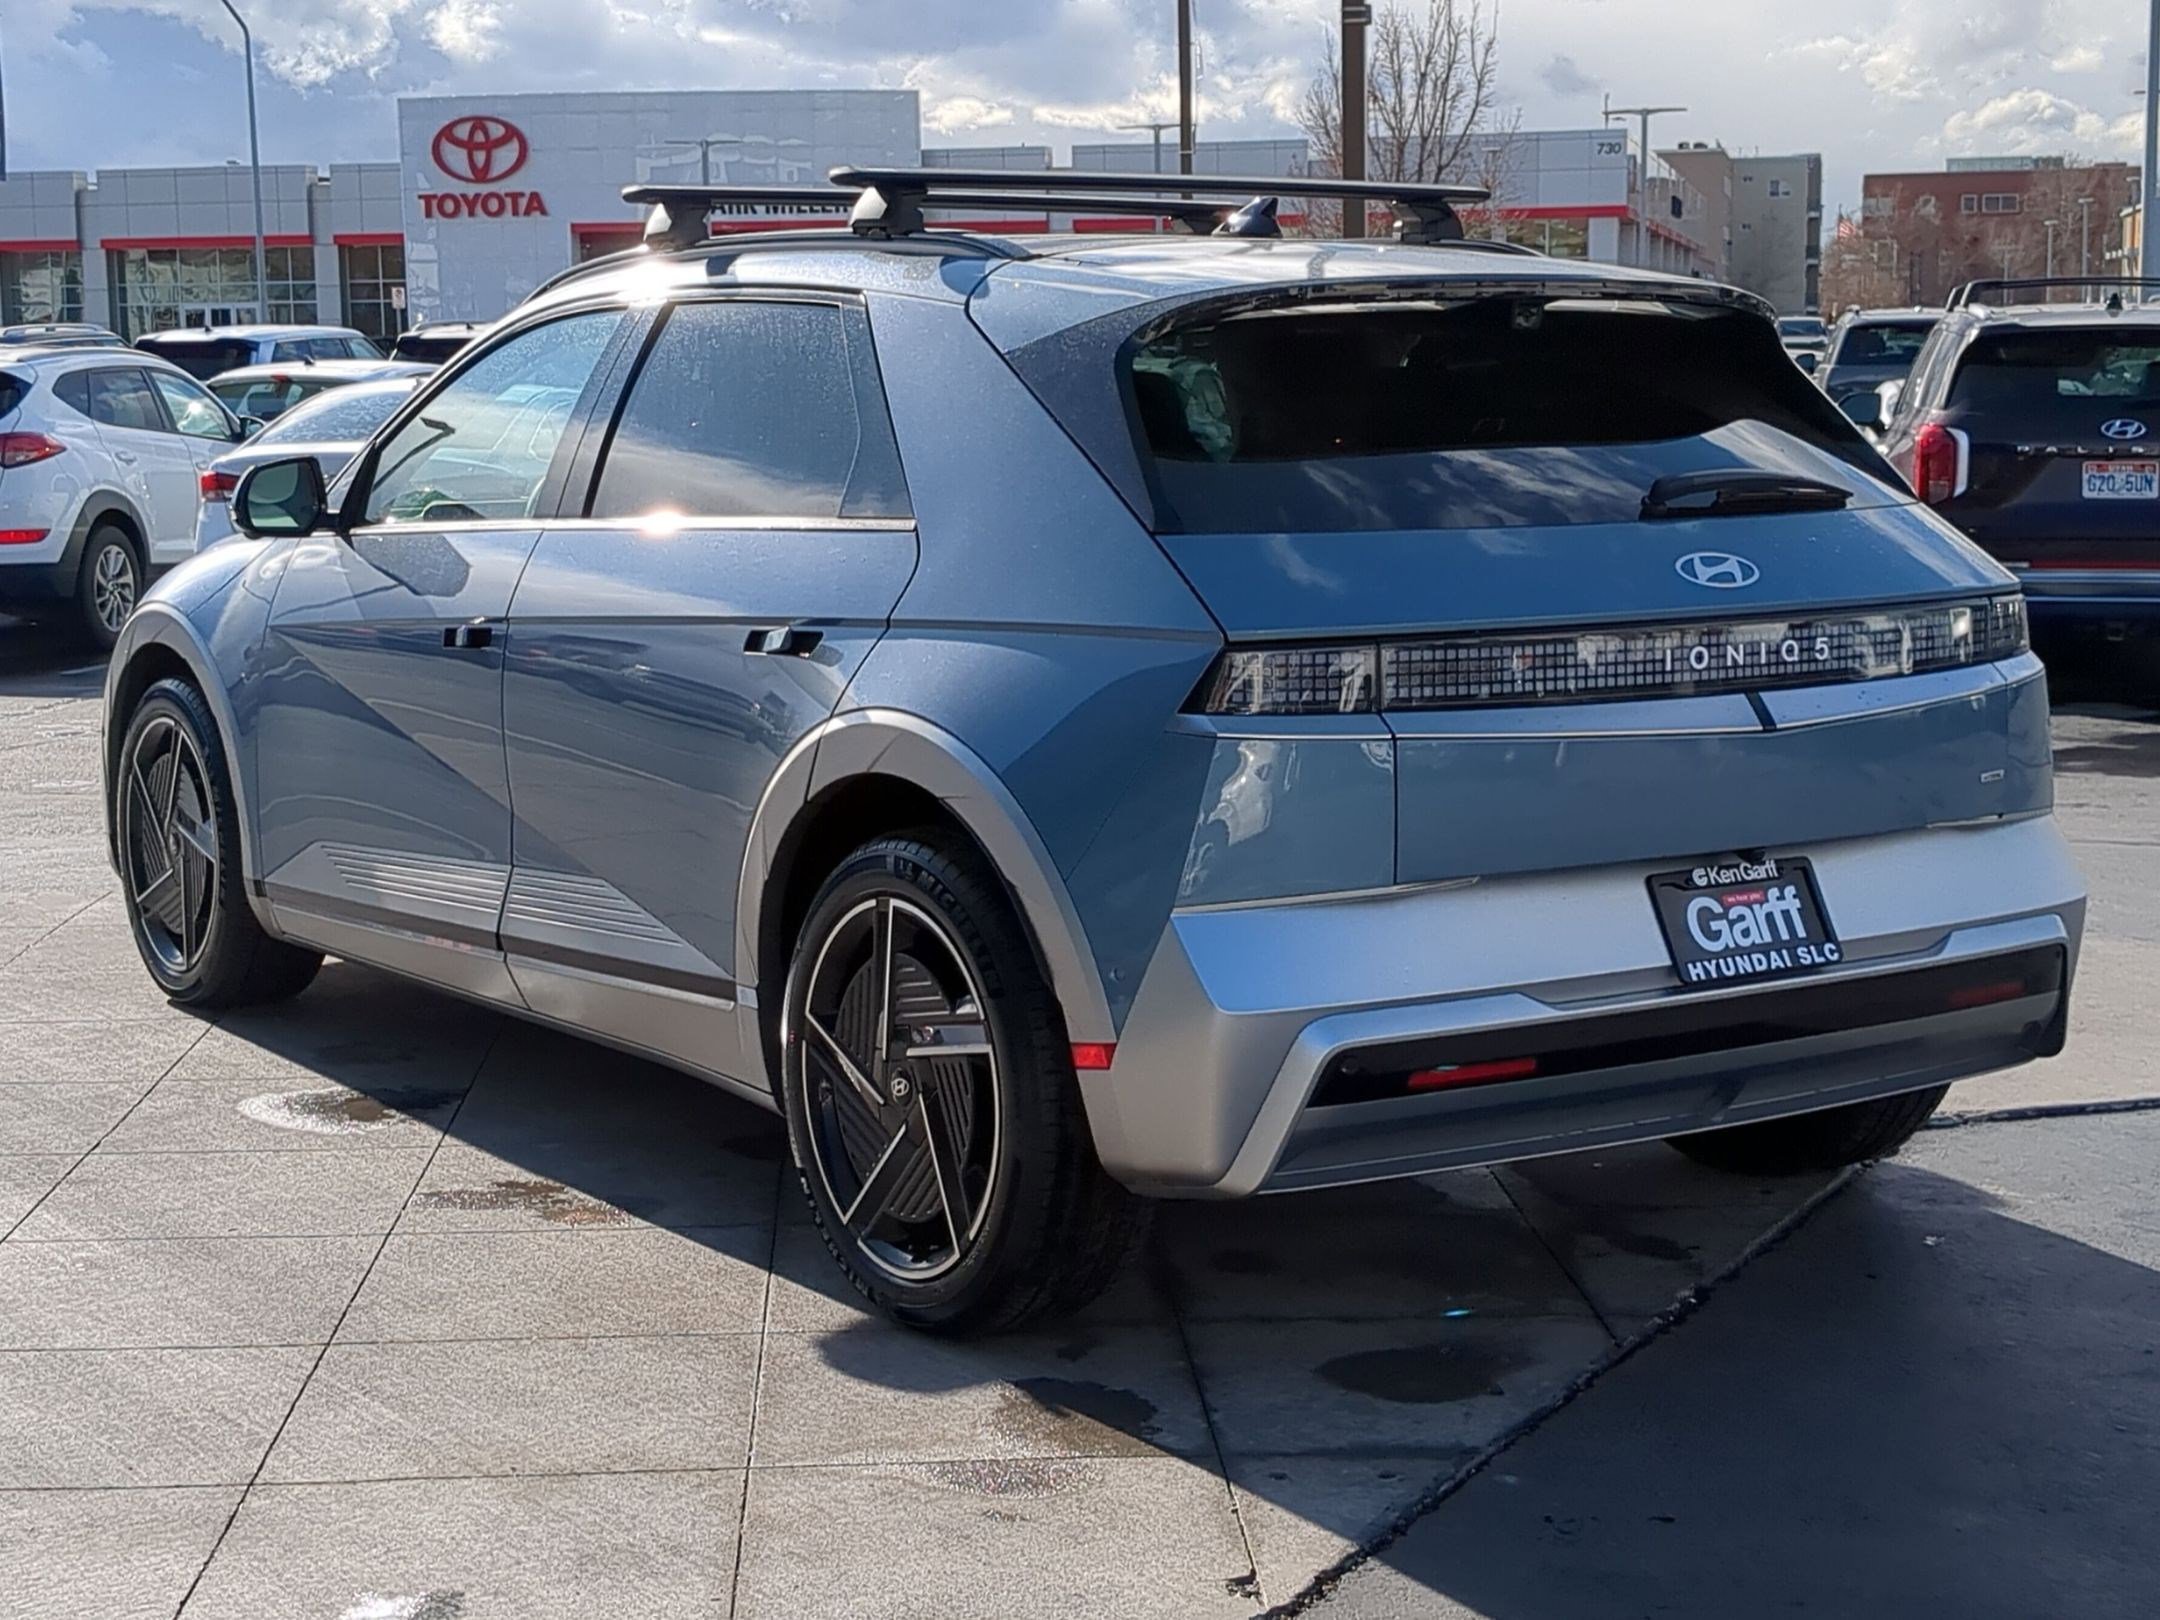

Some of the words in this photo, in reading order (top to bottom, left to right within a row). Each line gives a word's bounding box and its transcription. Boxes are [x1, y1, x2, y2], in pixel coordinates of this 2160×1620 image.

[1597, 142, 1622, 156] 730
[418, 191, 548, 219] TOYOTA
[710, 203, 757, 215] ARK
[1686, 885, 1807, 953] Garff
[1686, 950, 1793, 982] HYUNDAI
[1797, 943, 1840, 966] SLC
